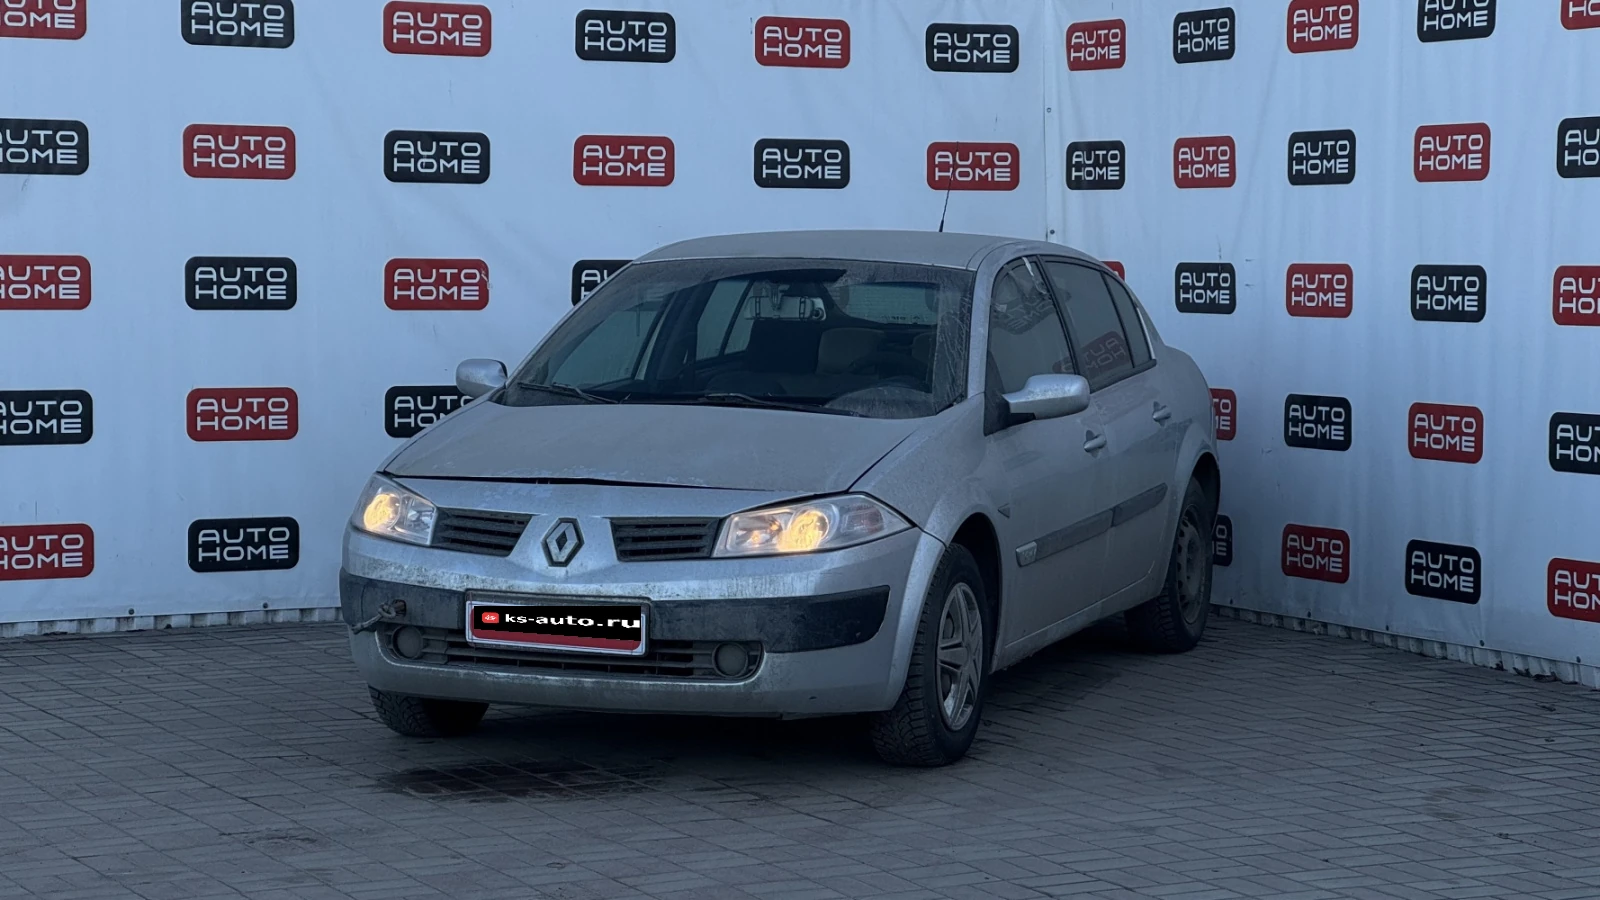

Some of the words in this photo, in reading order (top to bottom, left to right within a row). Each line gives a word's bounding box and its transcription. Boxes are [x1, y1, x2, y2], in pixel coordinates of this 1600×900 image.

[192, 2, 284, 19] AUTO
[1294, 5, 1352, 24] AUTO
[1569, 0, 1600, 17] HO
[0, 11, 75, 28] OME
[393, 12, 482, 29] AUTO
[1178, 18, 1229, 36] AUTO
[1424, 10, 1487, 31] HOME
[192, 20, 283, 37] HOME
[585, 20, 667, 36] AUTO
[764, 26, 842, 42] AUTO
[1294, 23, 1351, 42] HOME
[393, 29, 481, 46] HOME
[585, 37, 666, 52] HOME
[934, 33, 1010, 47] AUTO
[1072, 29, 1120, 45] AUTO
[1178, 35, 1228, 53] HOME
[764, 43, 841, 58] HOME
[934, 49, 1010, 63] HOME
[1071, 45, 1120, 61] HOME
[0, 130, 78, 145] UTO
[194, 135, 286, 151] AUTO
[1420, 135, 1483, 151] AUTO
[1565, 129, 1600, 146] AU
[0, 148, 77, 164] OME
[394, 141, 481, 156] AUTO
[583, 145, 666, 159] AUTO
[763, 149, 841, 162] AUTO
[1179, 146, 1229, 161] AUTO
[1293, 141, 1349, 156] AUTO
[194, 153, 284, 169] HOME
[935, 152, 1011, 165] AUTO
[1073, 150, 1120, 164] AUTO
[1420, 154, 1481, 170] HOME
[1565, 149, 1600, 166] HO
[394, 158, 479, 173] HOME
[583, 162, 665, 176] HOME
[763, 165, 840, 179] HOME
[1072, 167, 1119, 180] HOME
[1179, 163, 1229, 178] HOME
[1293, 159, 1348, 174] HOME
[936, 168, 1010, 181] HOME
[0, 266, 80, 280] UTO
[195, 267, 287, 282] AUTO
[394, 269, 480, 283] AUTO
[1180, 273, 1230, 286] AUTO
[1292, 274, 1347, 289] AUTO
[1417, 276, 1479, 292] AUTO
[1560, 277, 1600, 294] AU
[0, 284, 79, 299] OME
[196, 285, 286, 299] HOME
[394, 286, 479, 300] HOME
[1180, 289, 1229, 303] HOME
[1292, 292, 1345, 307] HOME
[1417, 295, 1478, 311] HOME
[1560, 297, 1600, 314] HO
[197, 398, 288, 413] AUTO
[1290, 405, 1345, 422] AUTO
[197, 415, 287, 430] HOME
[394, 412, 447, 428] HO
[1415, 414, 1476, 433] AUTO
[1289, 422, 1344, 440] HOME
[1414, 432, 1475, 452] HOME
[199, 527, 289, 544] AUTO
[1288, 535, 1343, 554] AUTO
[199, 545, 288, 561] HOME
[1287, 552, 1342, 572] HOME
[1412, 551, 1474, 573] AUTO
[1411, 569, 1473, 592] HOME
